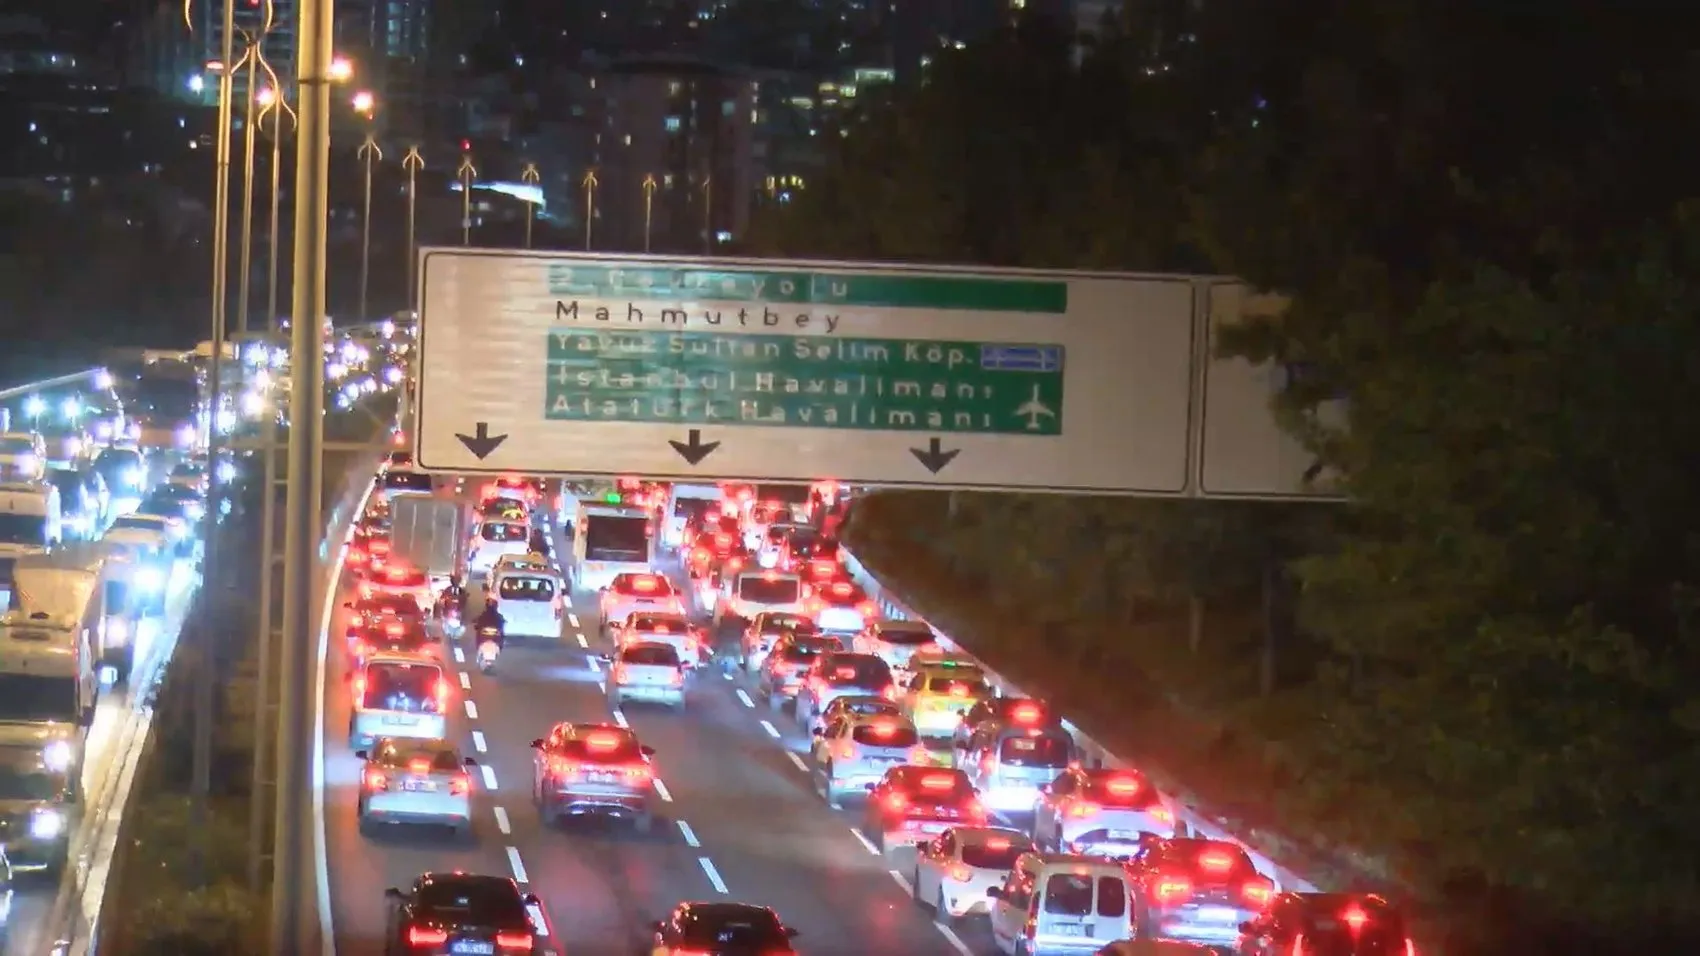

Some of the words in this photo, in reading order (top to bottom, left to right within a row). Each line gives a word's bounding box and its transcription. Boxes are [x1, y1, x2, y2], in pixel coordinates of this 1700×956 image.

[556, 300, 840, 333] Mahmutbey
[669, 334, 780, 358] Sultan
[794, 337, 889, 363] Selim
[904, 343, 975, 371] Köp.
[740, 399, 991, 428] Havalimanı
